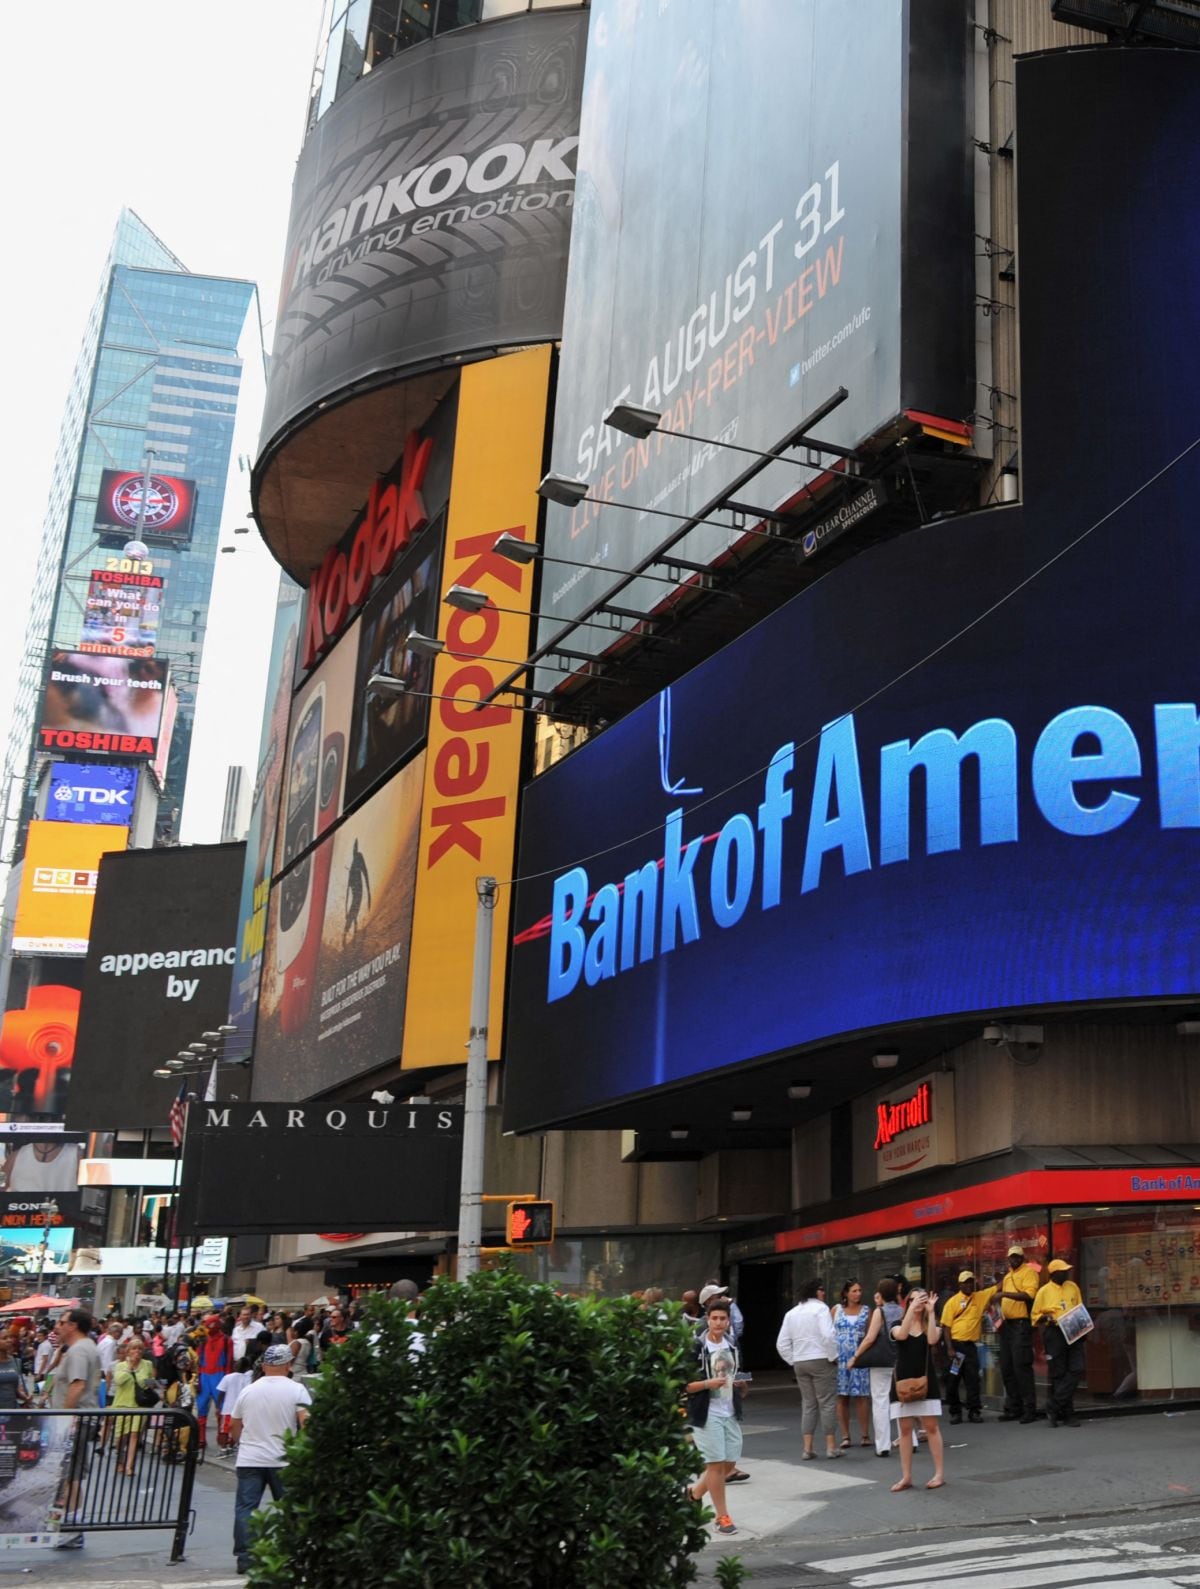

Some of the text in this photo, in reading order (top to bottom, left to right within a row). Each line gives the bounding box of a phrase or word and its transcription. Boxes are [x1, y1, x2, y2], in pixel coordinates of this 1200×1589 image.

[316, 189, 575, 287] driving emotion
[642, 218, 784, 409] AUGUST
[794, 159, 846, 260] 31
[801, 306, 871, 375] twitter.com/ufc
[570, 235, 845, 540] LIVE ON PAY-PER-VIEW
[841, 500, 878, 530] SPECTACOLOR
[303, 430, 434, 670] Kodak
[106, 557, 153, 575] 2013
[92, 570, 162, 588] TOSHIBA
[87, 598, 160, 612] can you do
[106, 587, 141, 600] What
[115, 612, 127, 622] in
[111, 626, 126, 642] 5
[79, 642, 155, 657] minutes?
[51, 671, 162, 690] Brush your teeth
[427, 524, 526, 870] Kodak
[40, 728, 154, 754] TOSHIBA
[72, 787, 130, 806] TDK
[547, 807, 704, 1004] Bank
[710, 741, 795, 930] of
[166, 976, 200, 1001] by
[205, 1108, 453, 1129] MARQUIS
[873, 1083, 929, 1150] Marriott
[1131, 1176, 1167, 1191] Bank
[1168, 1175, 1183, 1190] of
